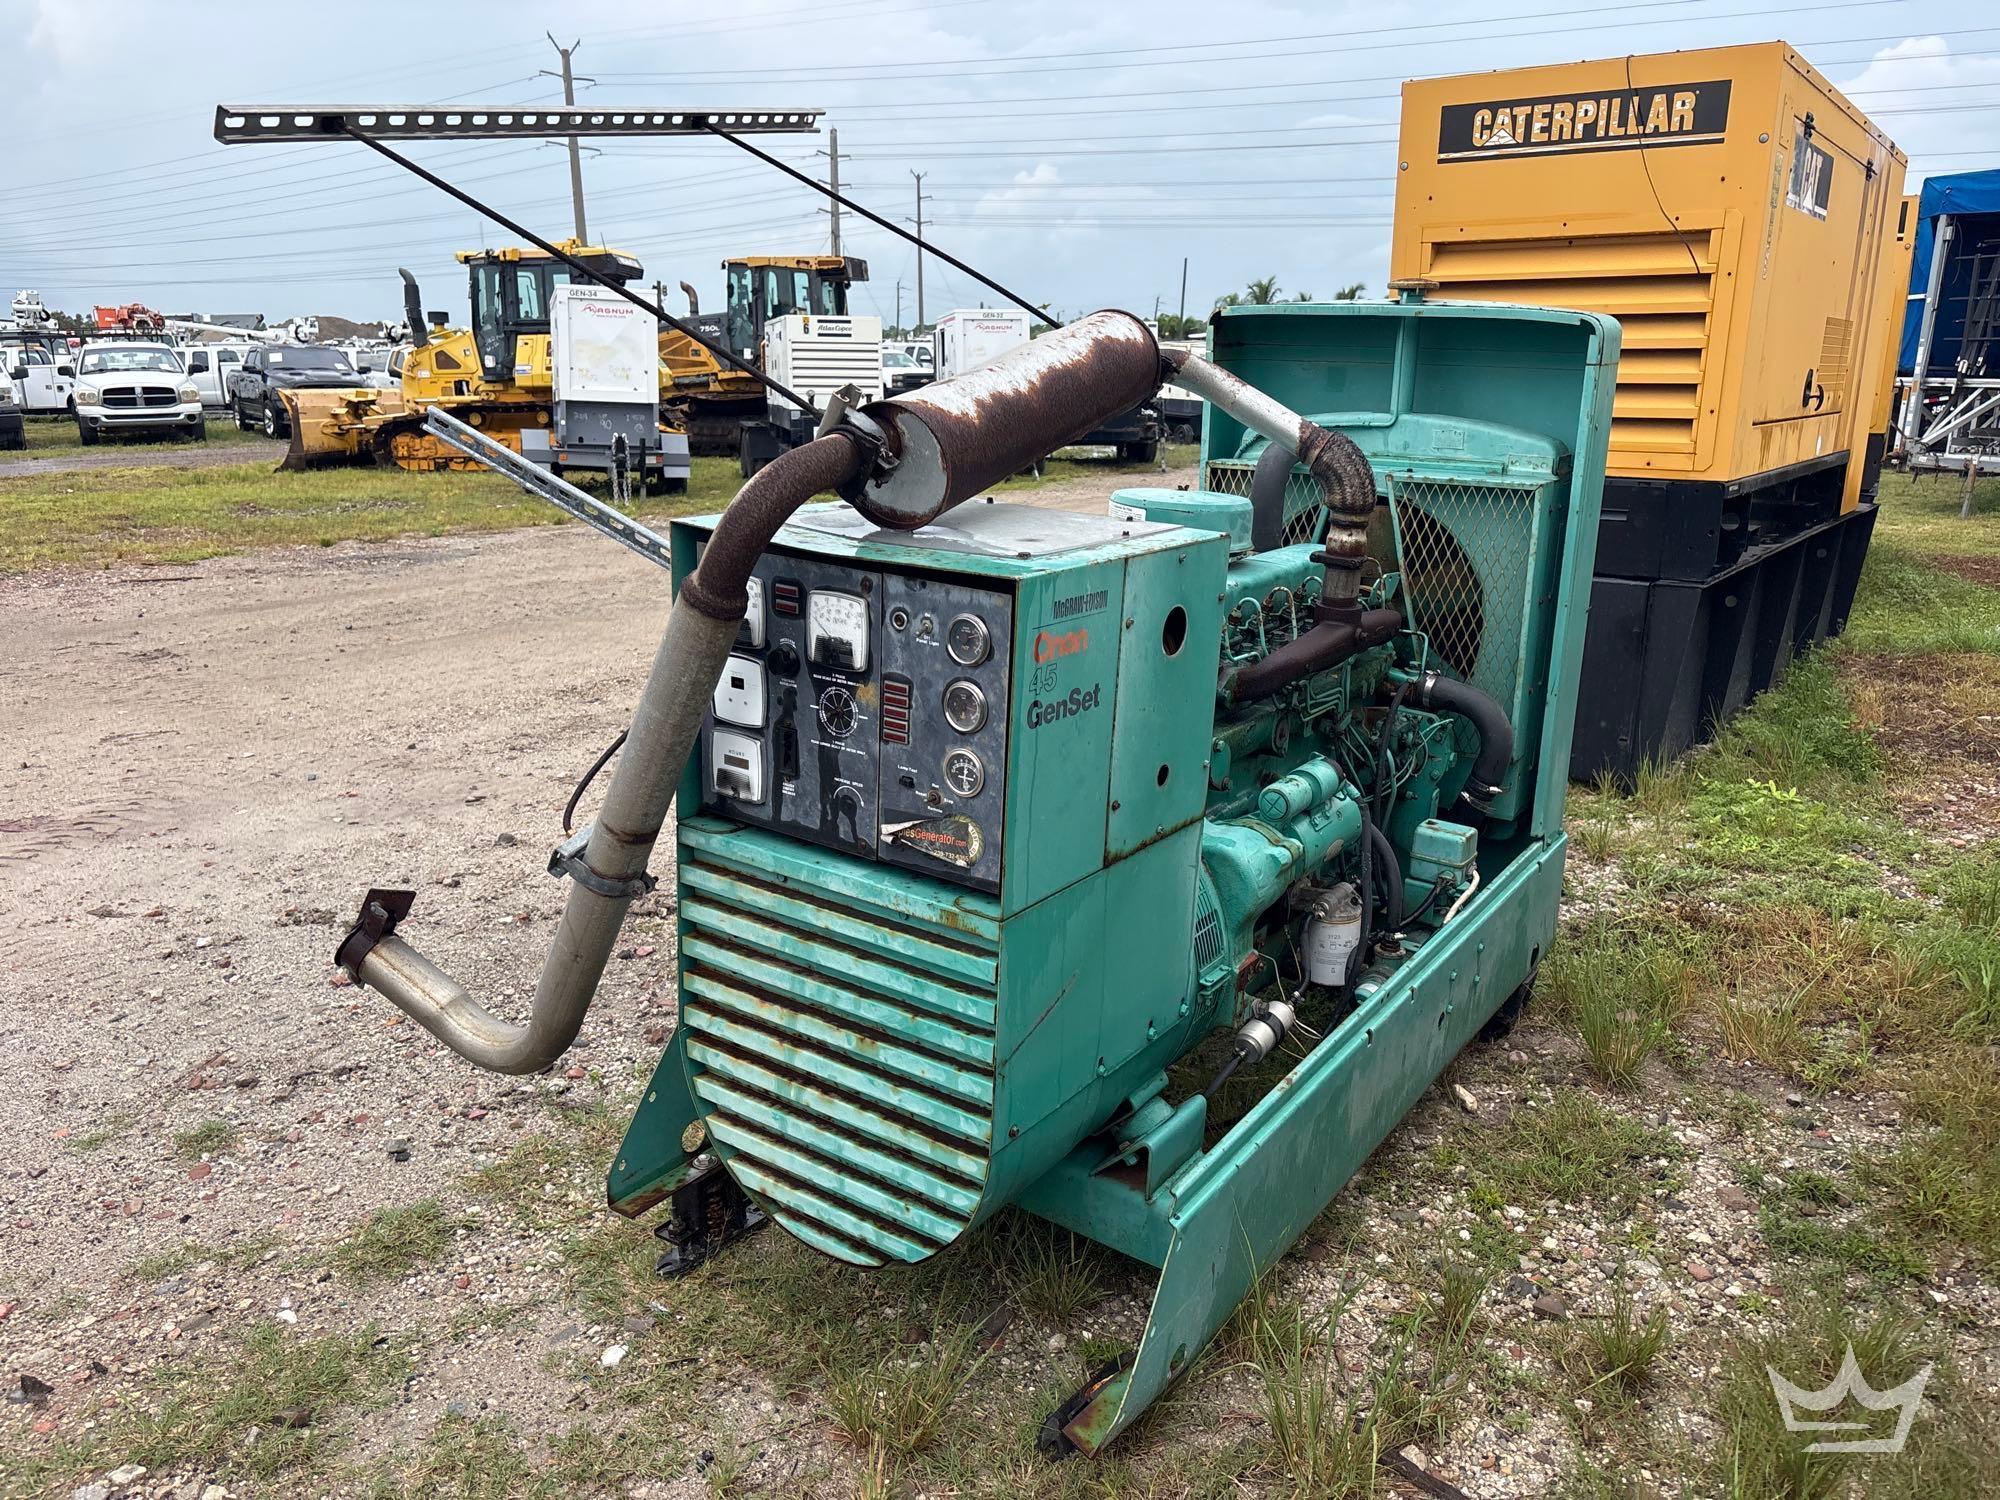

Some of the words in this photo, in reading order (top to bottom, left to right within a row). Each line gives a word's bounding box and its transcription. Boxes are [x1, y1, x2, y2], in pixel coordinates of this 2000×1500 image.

[1472, 91, 1697, 147] CATERPILLAR
[1801, 146, 1824, 211] CAT
[569, 289, 598, 298] GEN-34
[581, 303, 634, 316] MAGNUM
[1028, 663, 1058, 696] 45
[1026, 682, 1101, 730] GenSet
